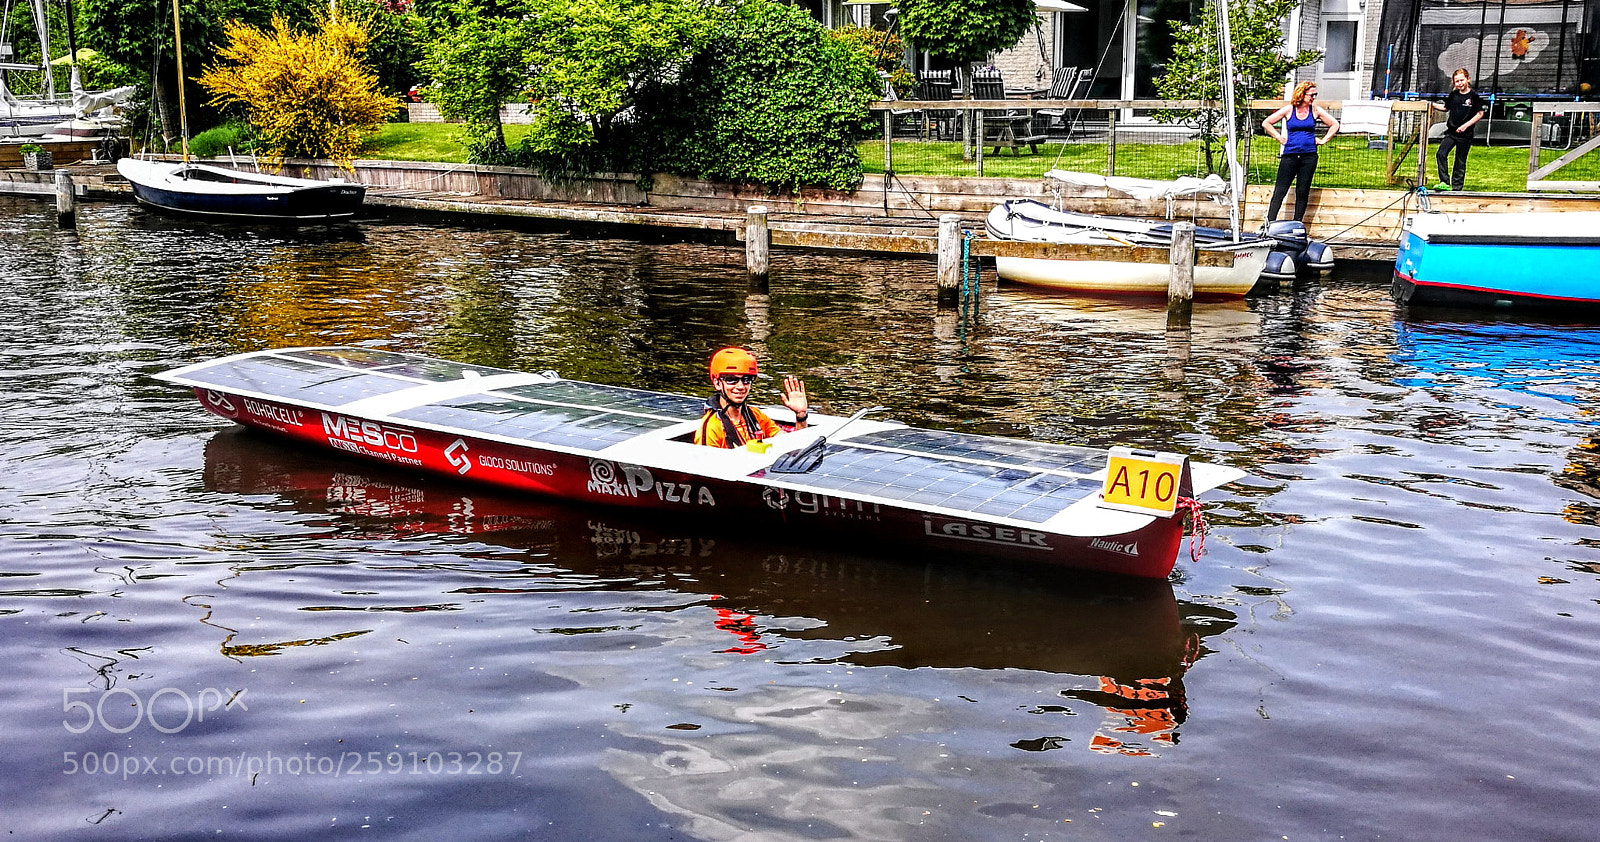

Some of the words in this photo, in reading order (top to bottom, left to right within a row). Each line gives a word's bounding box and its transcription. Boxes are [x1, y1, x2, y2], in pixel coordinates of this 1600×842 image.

[321, 412, 418, 453] MESCO
[358, 445, 392, 461] Channel
[390, 452, 423, 466] Partner
[478, 454, 505, 469] GIOCO
[1107, 465, 1175, 502] A10
[824, 510, 881, 522] SYSTEMS
[924, 519, 1049, 547] LASER
[1090, 537, 1124, 552] Nautic
